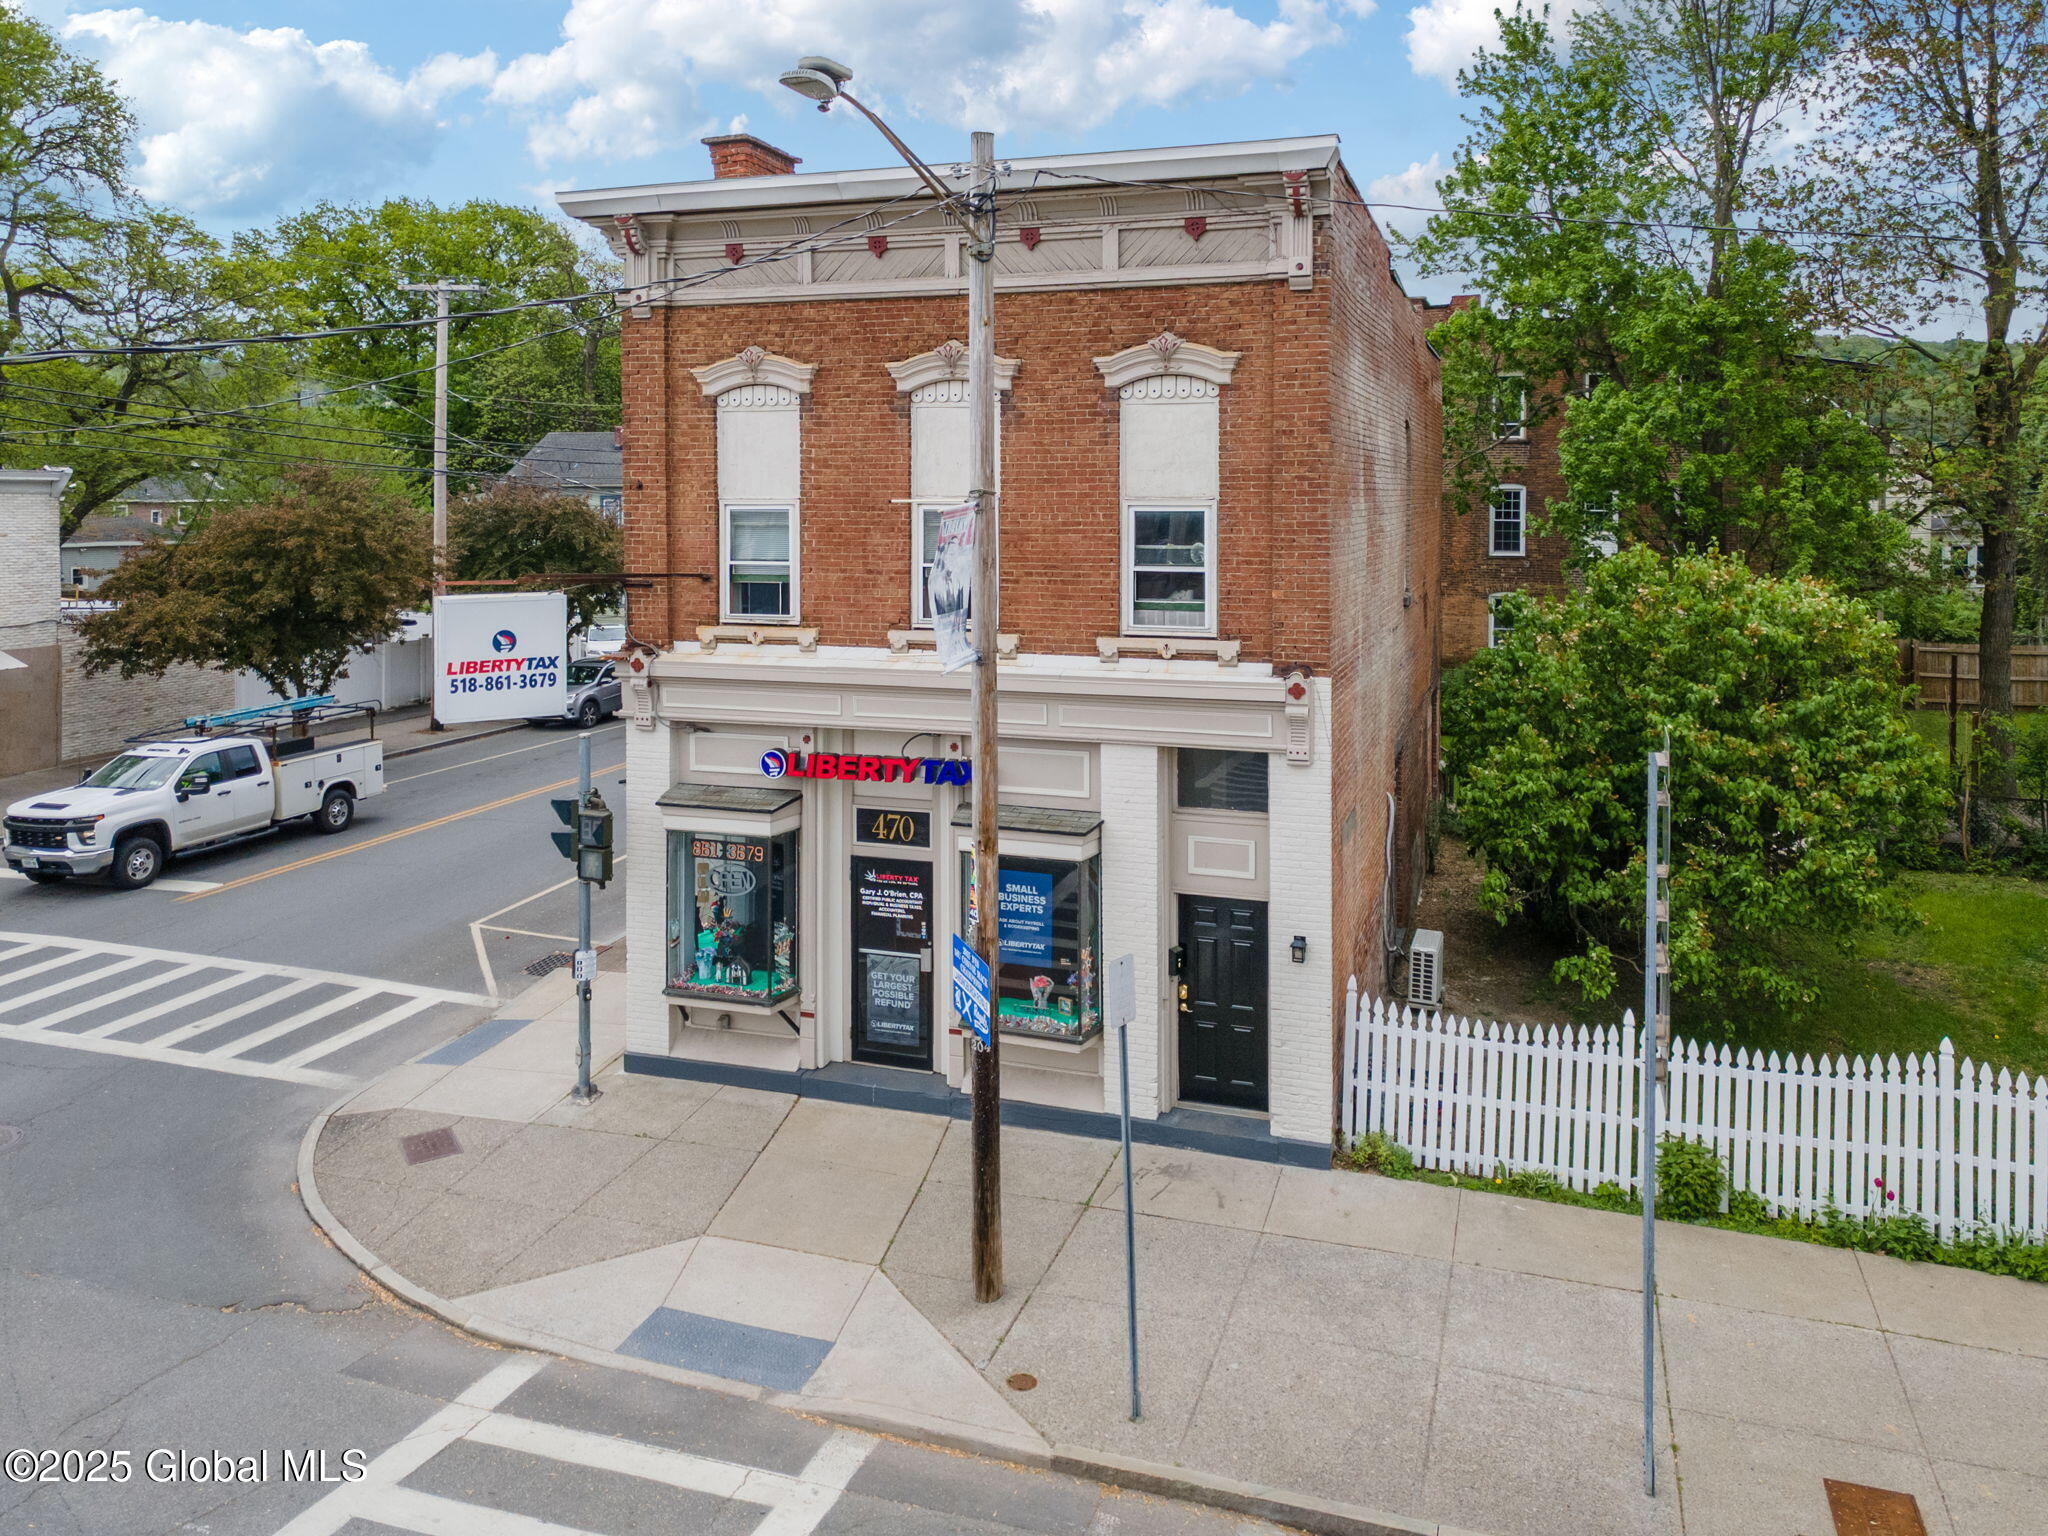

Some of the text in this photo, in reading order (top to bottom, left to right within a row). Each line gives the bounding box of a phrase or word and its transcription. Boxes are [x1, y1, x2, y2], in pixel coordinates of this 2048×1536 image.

[446, 656, 560, 676] LIBERTYTAX
[450, 672, 557, 694] 518-861-3679
[871, 813, 914, 842] 470
[1005, 883, 1038, 895] SMALL
[998, 892, 1047, 905] BUSINESS
[1000, 902, 1044, 914] EXPERTS
[871, 971, 915, 983] GET YOUR
[873, 980, 913, 991] LARGEST
[872, 989, 914, 1000] POSSIBLE
